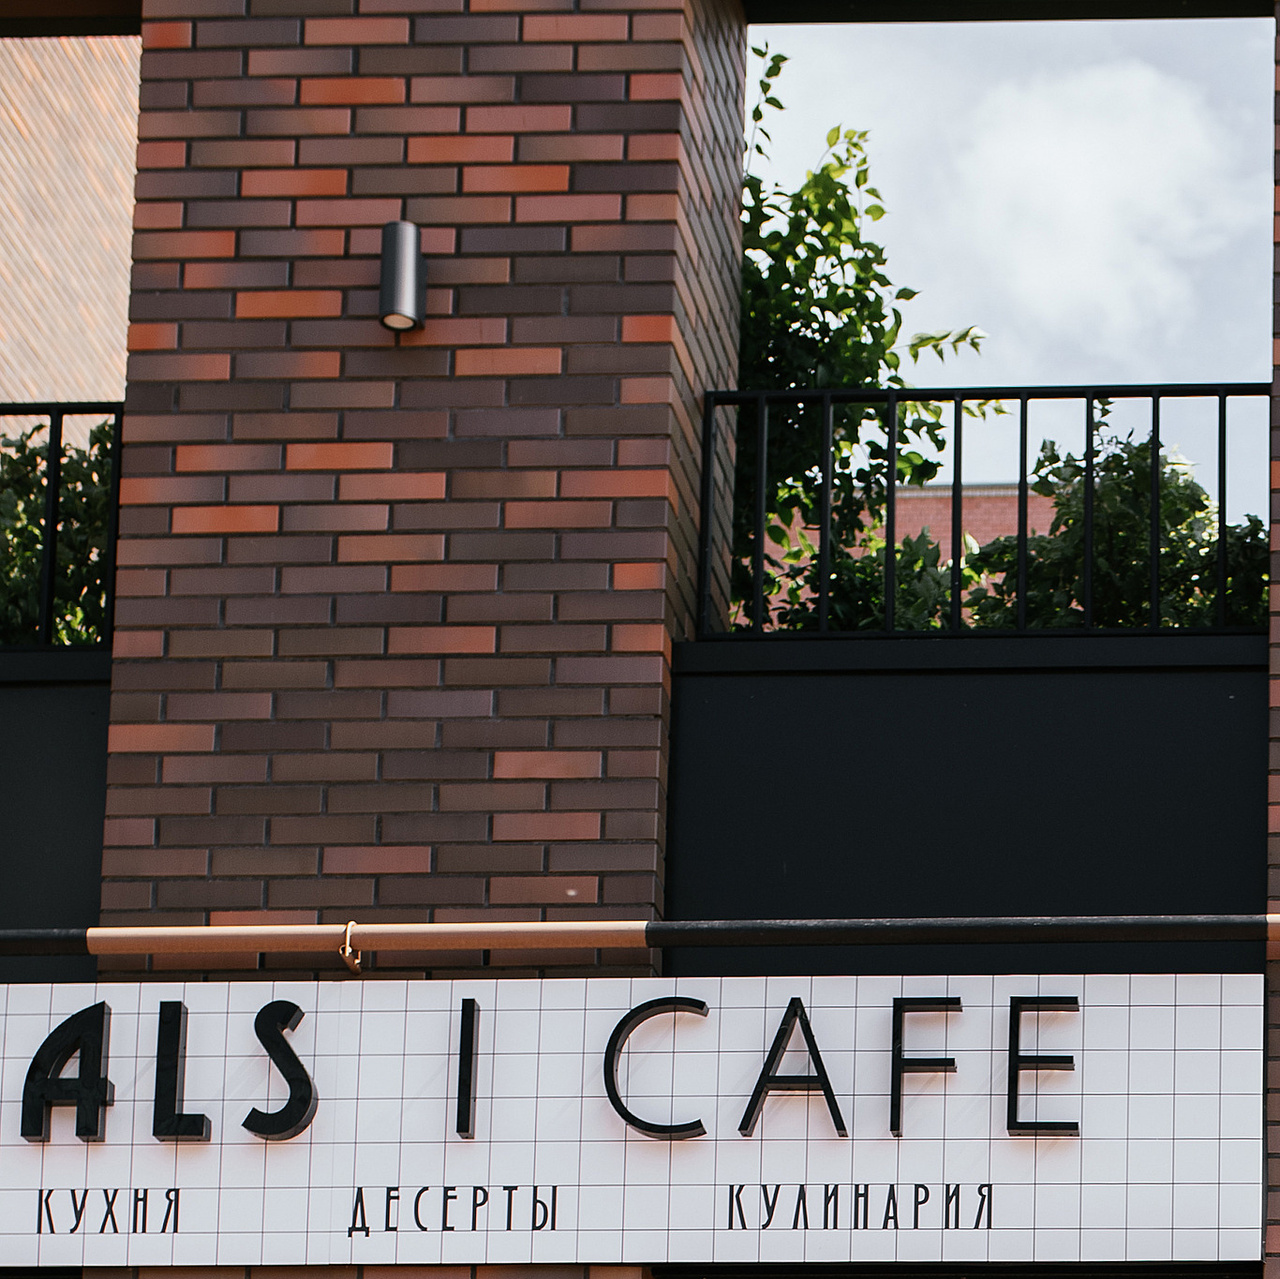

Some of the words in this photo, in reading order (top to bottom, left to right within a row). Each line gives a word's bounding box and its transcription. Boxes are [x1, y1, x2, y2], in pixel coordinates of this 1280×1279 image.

[20, 999, 320, 1143] ALS
[603, 995, 1081, 1141] CAFE
[36, 1187, 181, 1235] КУХНЯ
[347, 1184, 558, 1238] ДЕСЕРТЫ
[727, 1183, 994, 1231] КУЛИНАРИЯ
